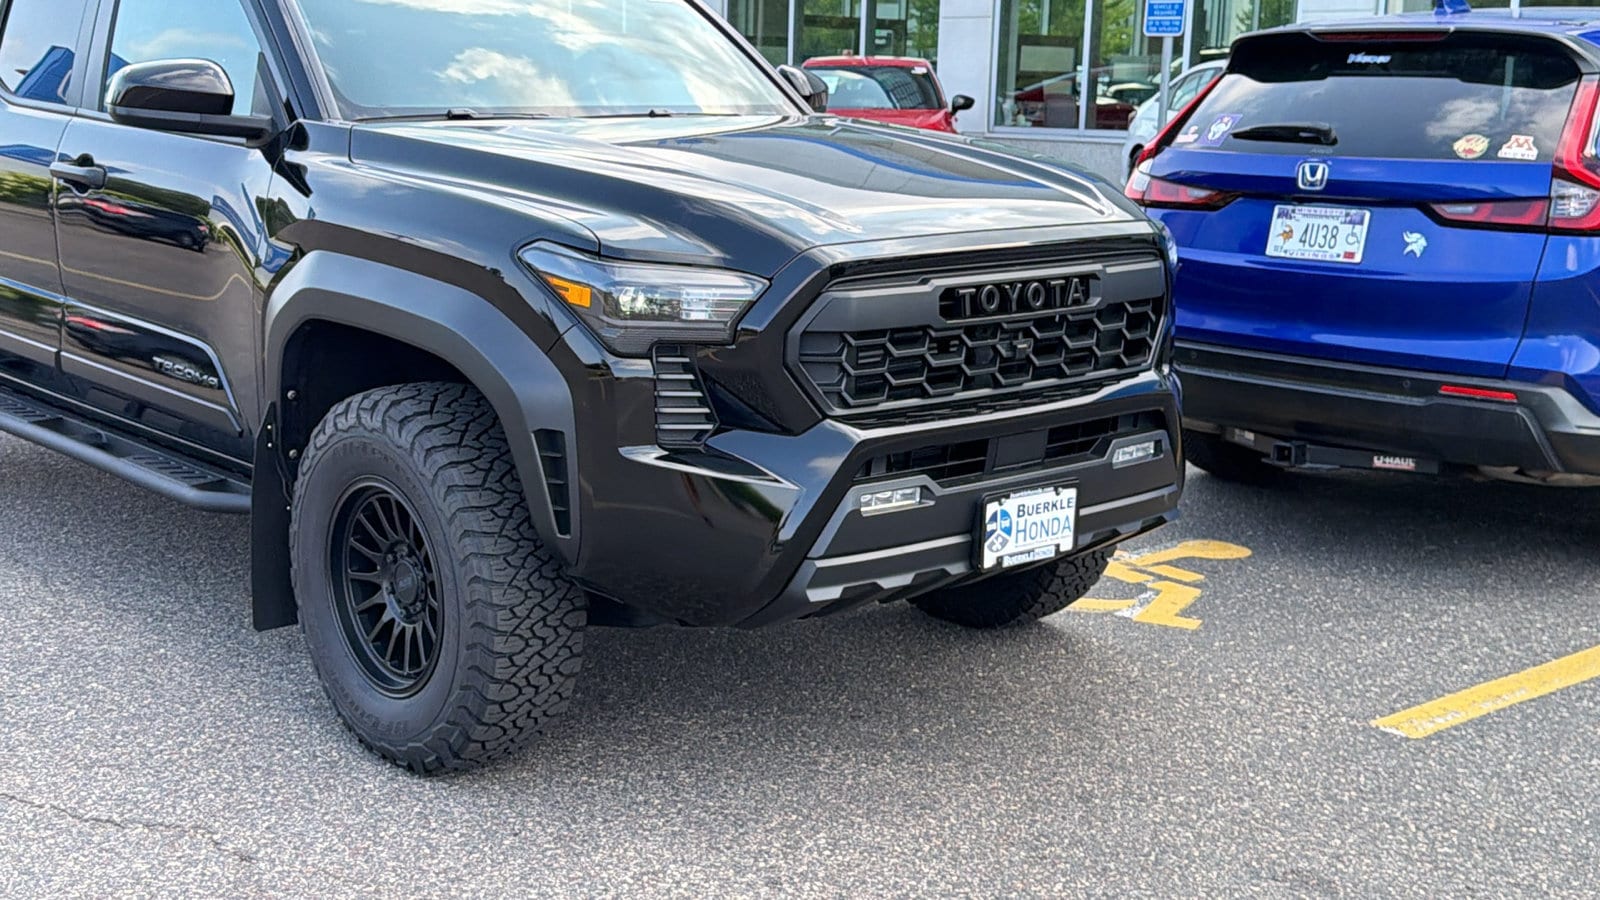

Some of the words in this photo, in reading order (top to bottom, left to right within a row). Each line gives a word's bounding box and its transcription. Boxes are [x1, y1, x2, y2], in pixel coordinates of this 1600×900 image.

[1299, 222, 1340, 250] 4U38
[955, 277, 1086, 318] TOYOTA
[152, 355, 219, 389] TACOMA
[1373, 455, 1416, 467] U-HAUL
[1016, 497, 1075, 519] BUERKLE
[1014, 514, 1072, 545] HONDA
